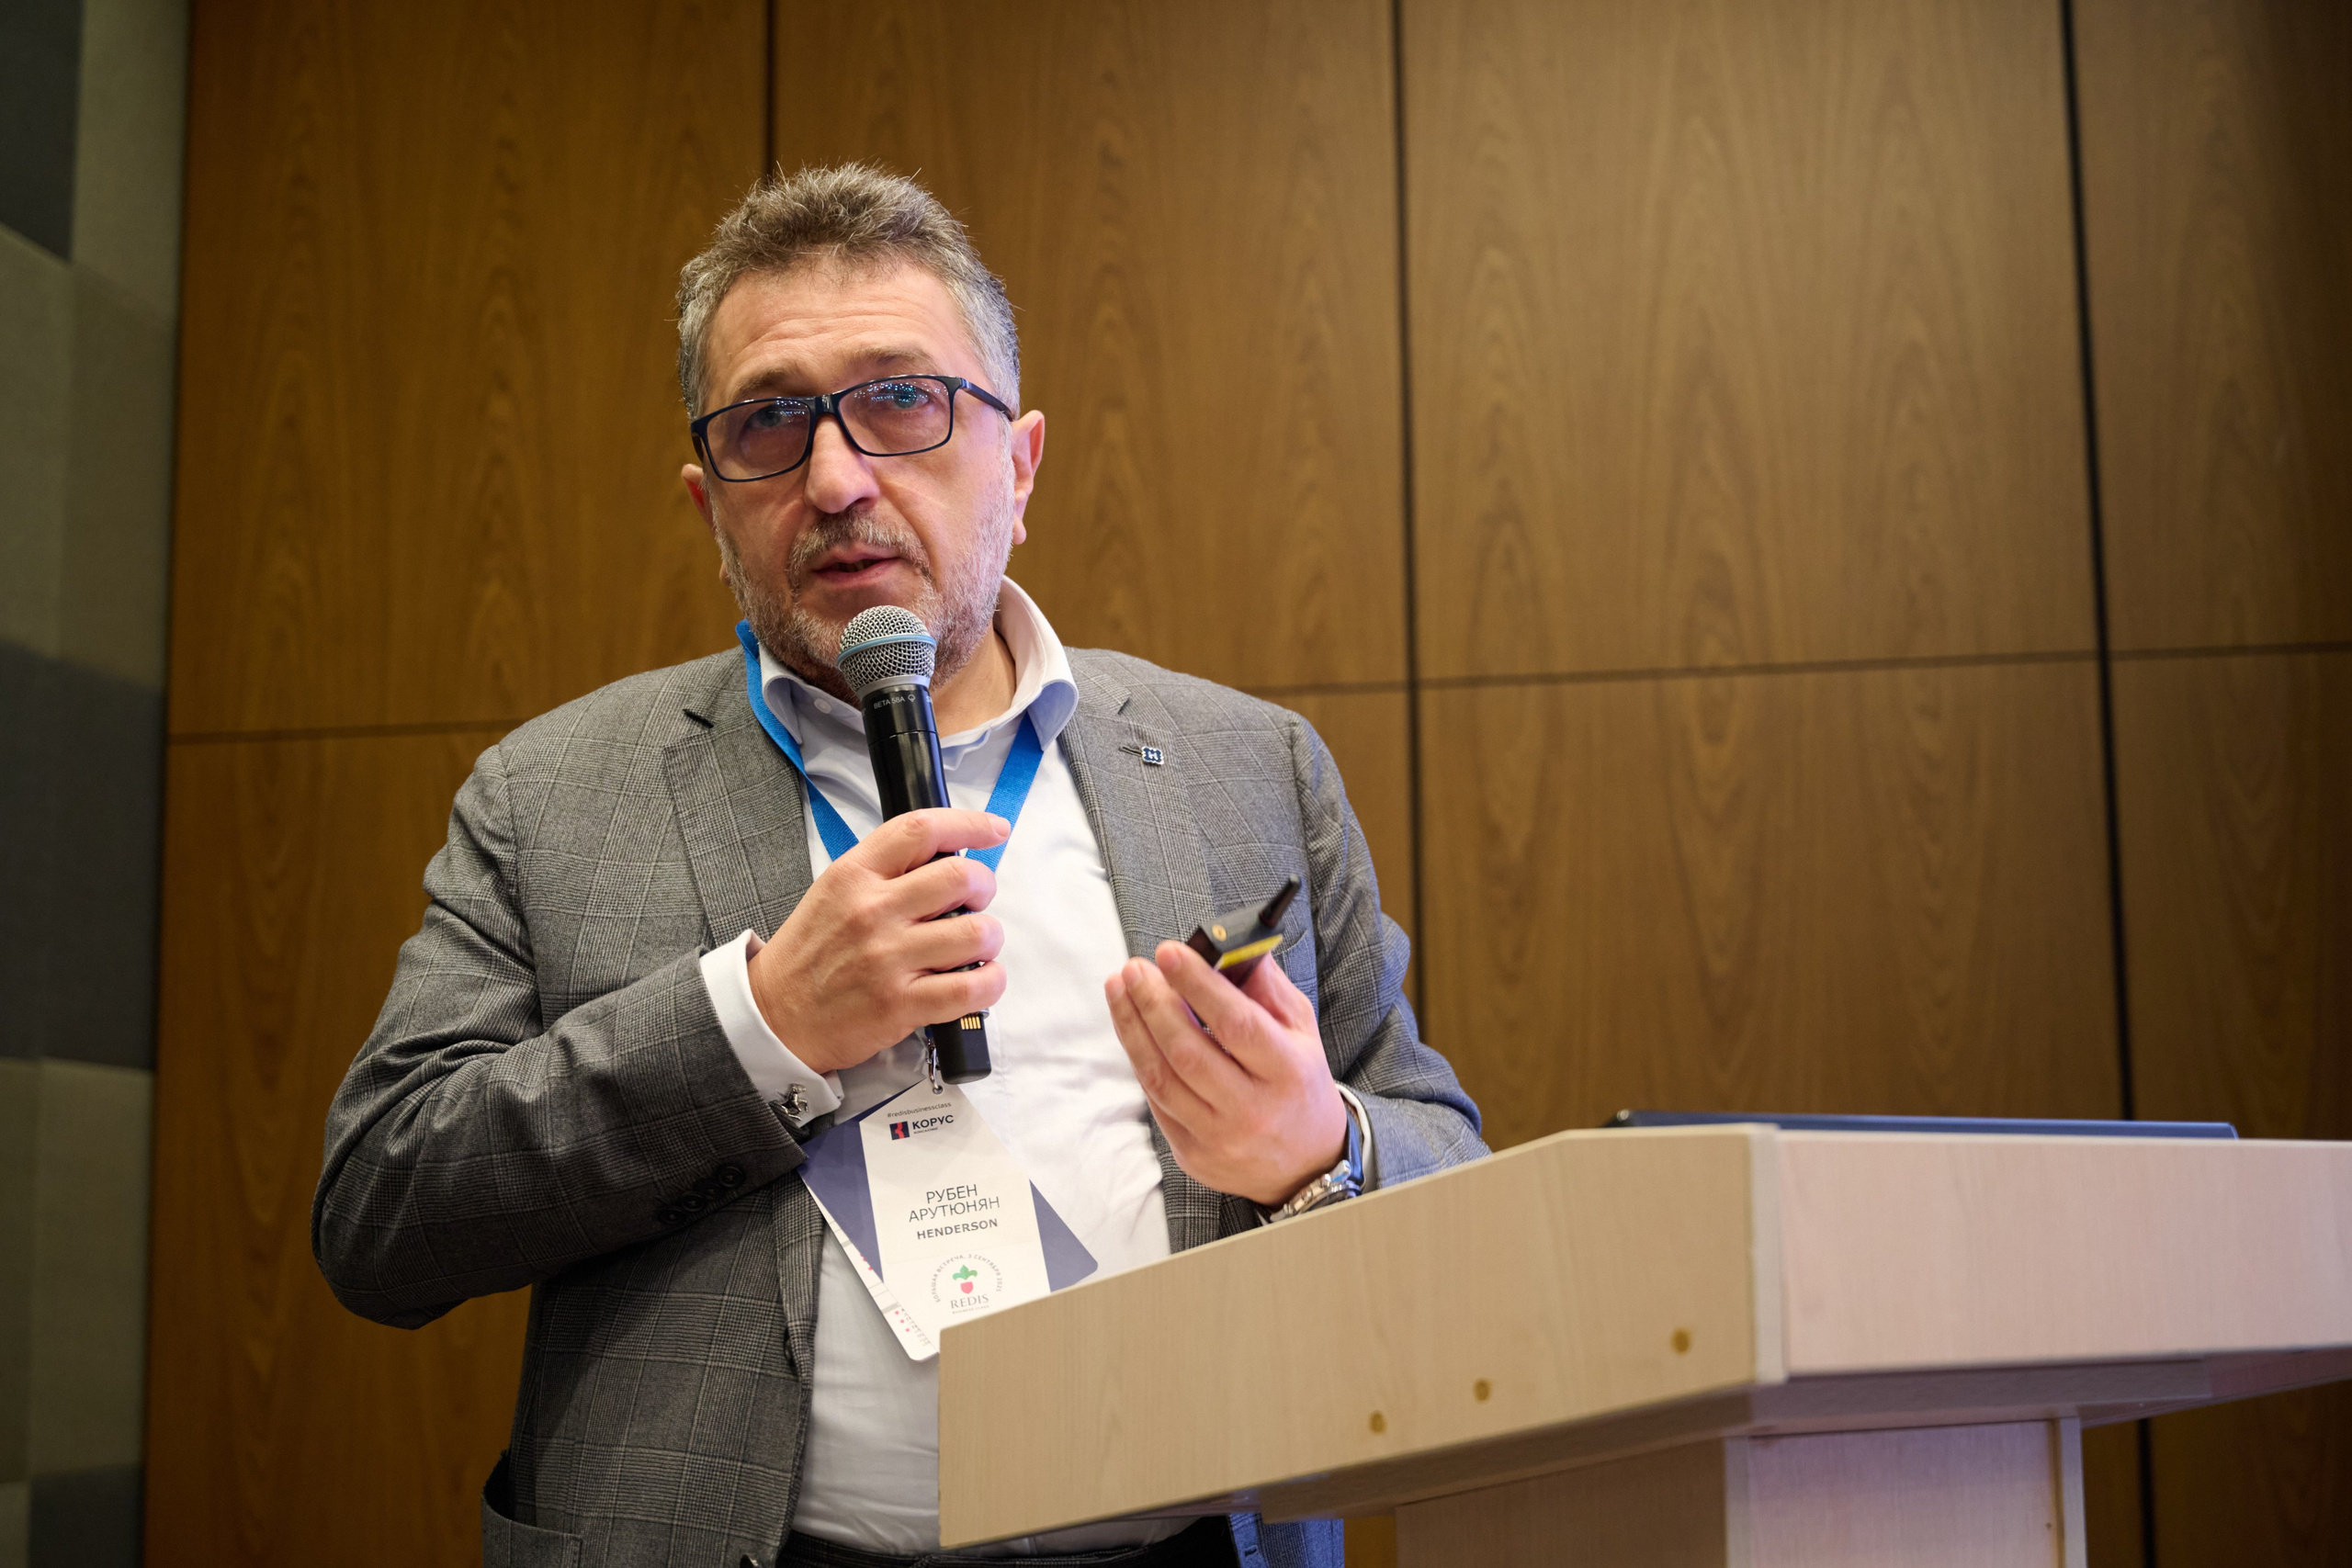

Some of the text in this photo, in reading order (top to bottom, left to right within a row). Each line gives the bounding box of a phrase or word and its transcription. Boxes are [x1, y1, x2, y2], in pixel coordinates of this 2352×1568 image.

[874, 696, 905, 709] BETA 58A
[888, 1102, 952, 1118] #redisbusinessclass
[912, 1114, 954, 1129] КОРУС
[926, 1184, 978, 1204] РУБЕН
[909, 1196, 1000, 1223] АРУТЮНЯН
[917, 1218, 998, 1239] HENDERSON
[974, 1254, 1001, 1276] СЕНТЯБРЯ
[950, 1294, 989, 1309] REDIS
